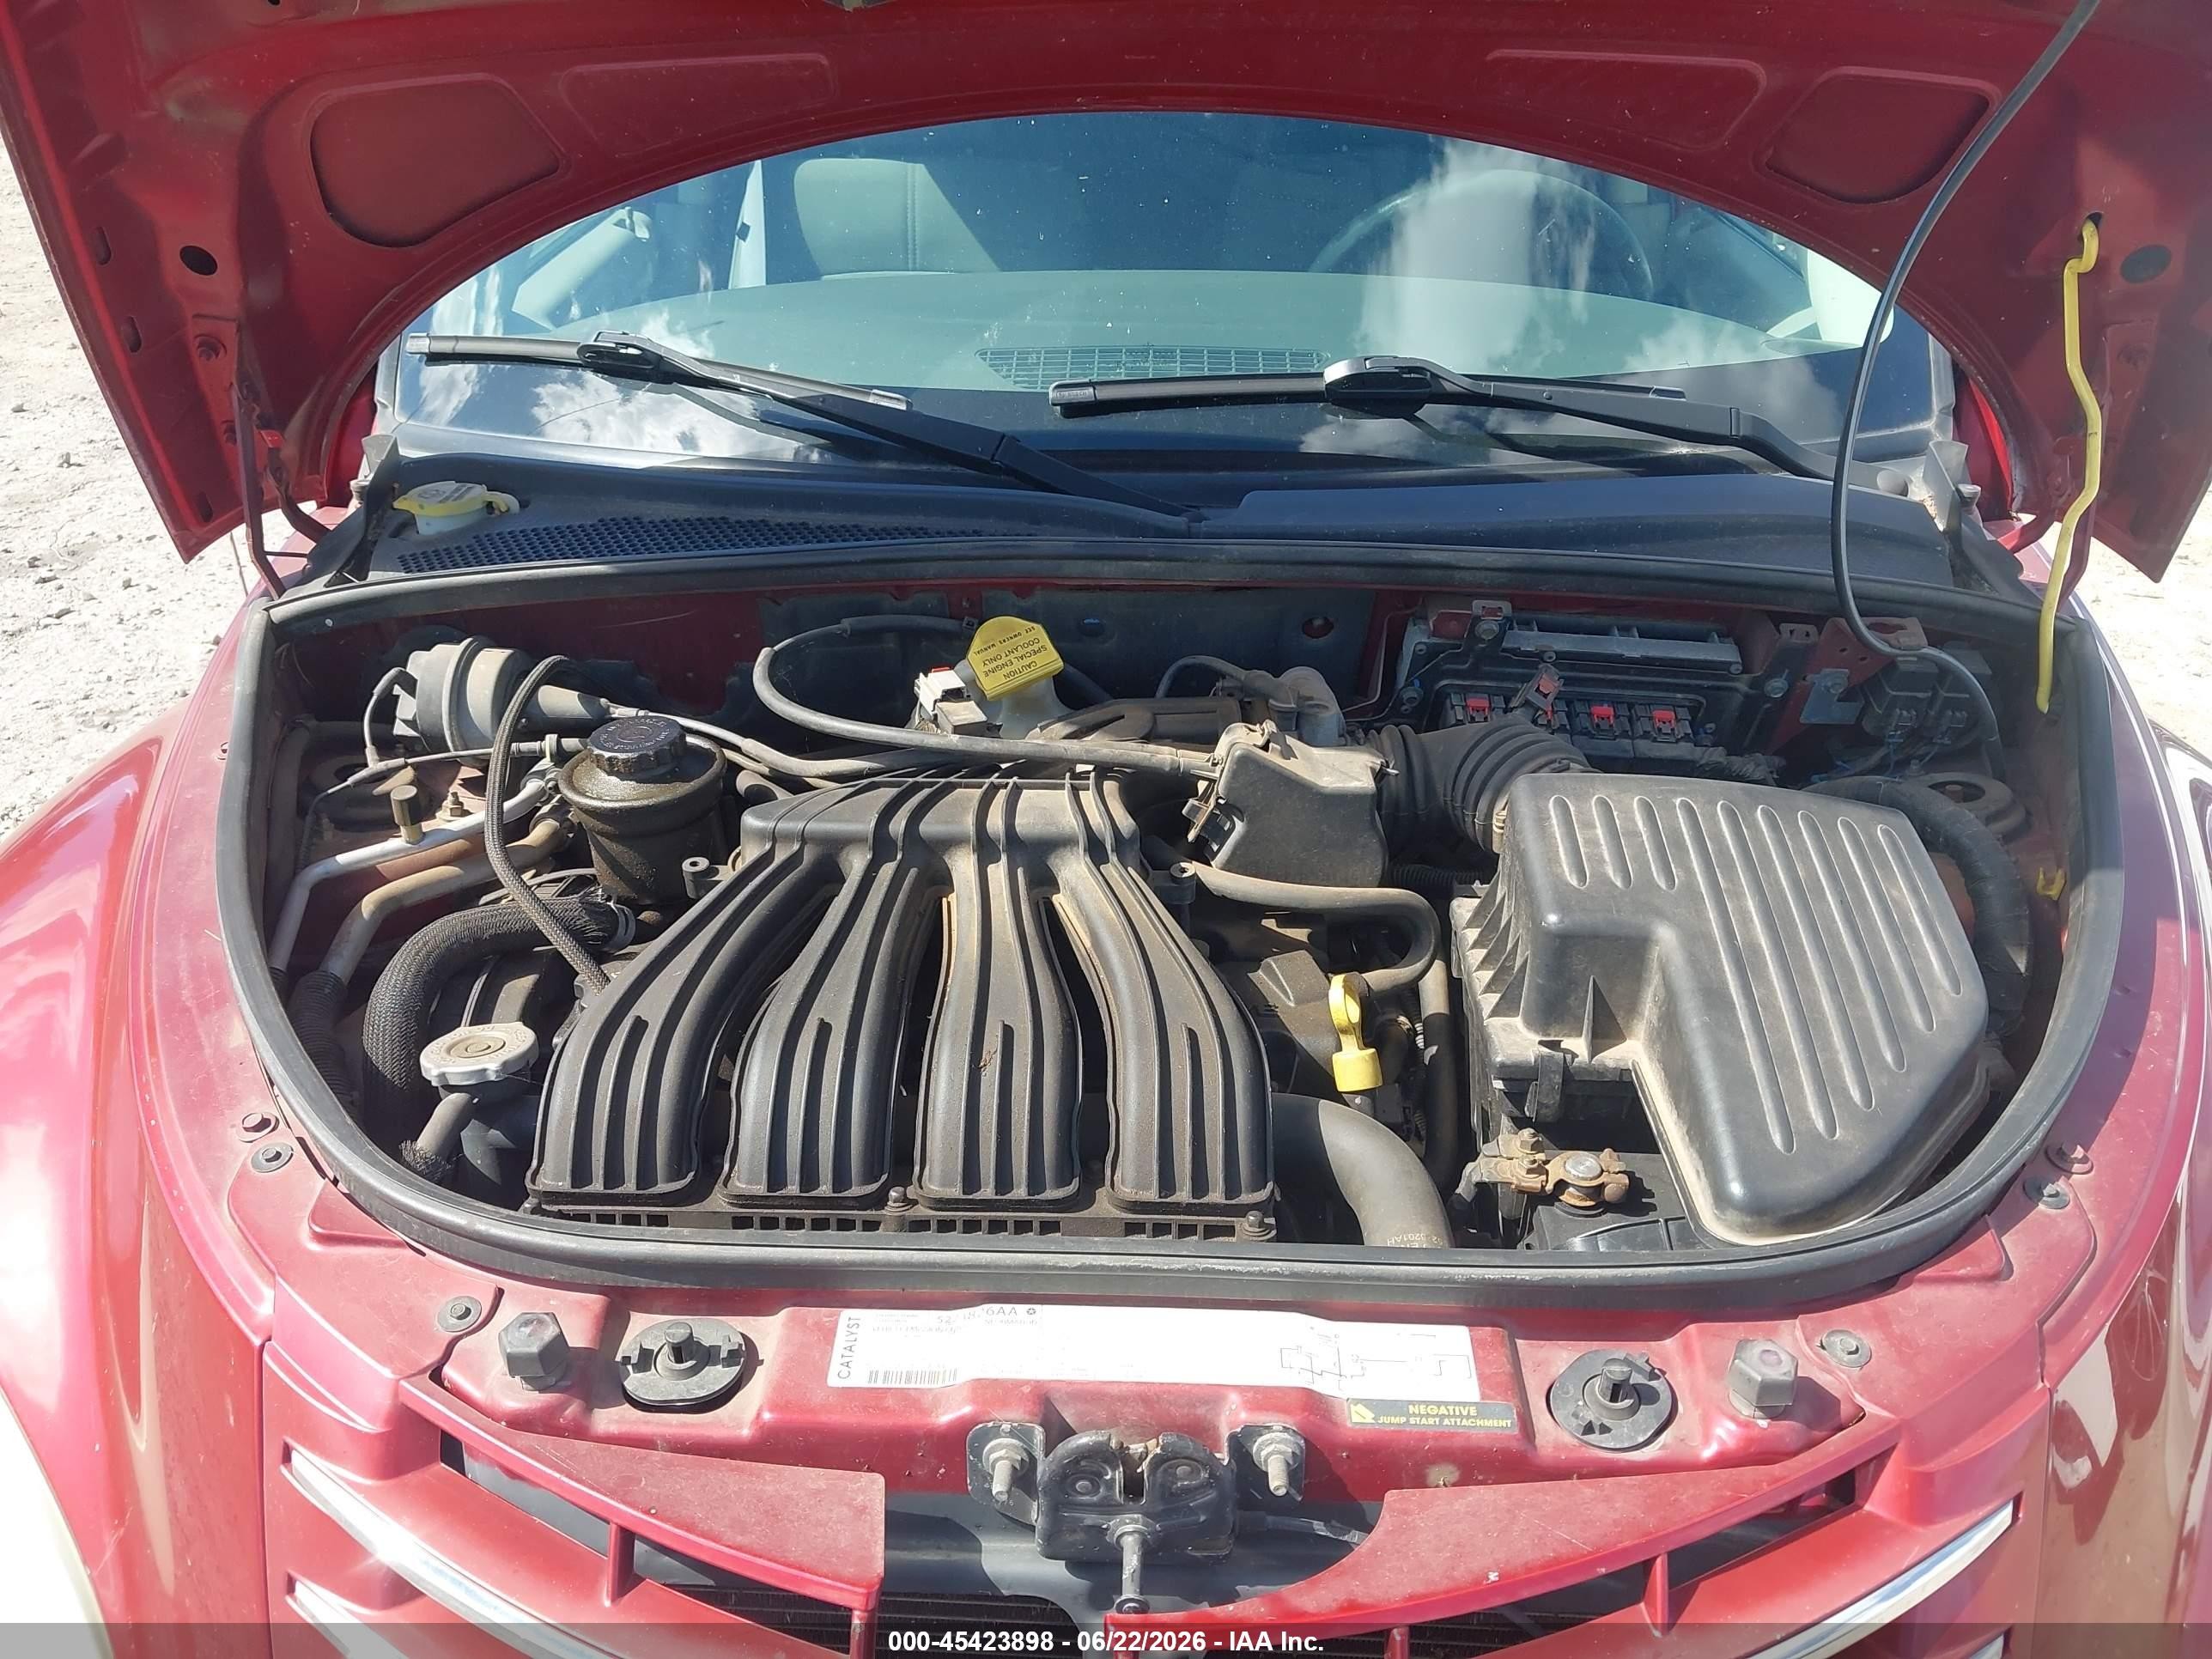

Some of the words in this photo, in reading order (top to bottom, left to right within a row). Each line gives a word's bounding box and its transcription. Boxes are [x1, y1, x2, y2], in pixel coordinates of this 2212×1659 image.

[974, 642, 996, 656] MANUAL
[1005, 637, 1040, 658] COOLANT
[1013, 644, 1048, 663] SPECIAL
[982, 653, 1003, 667] ONLY
[982, 659, 1014, 678] ENGINE
[1003, 660, 1037, 680] CAUTION
[837, 1316, 861, 1380] CATALYST
[1408, 1405, 1477, 1416] NEGATIVE
[1377, 1416, 1407, 1425] JUMP
[1409, 1417, 1442, 1425] START
[1443, 1418, 1512, 1428] ATTACHMENT
